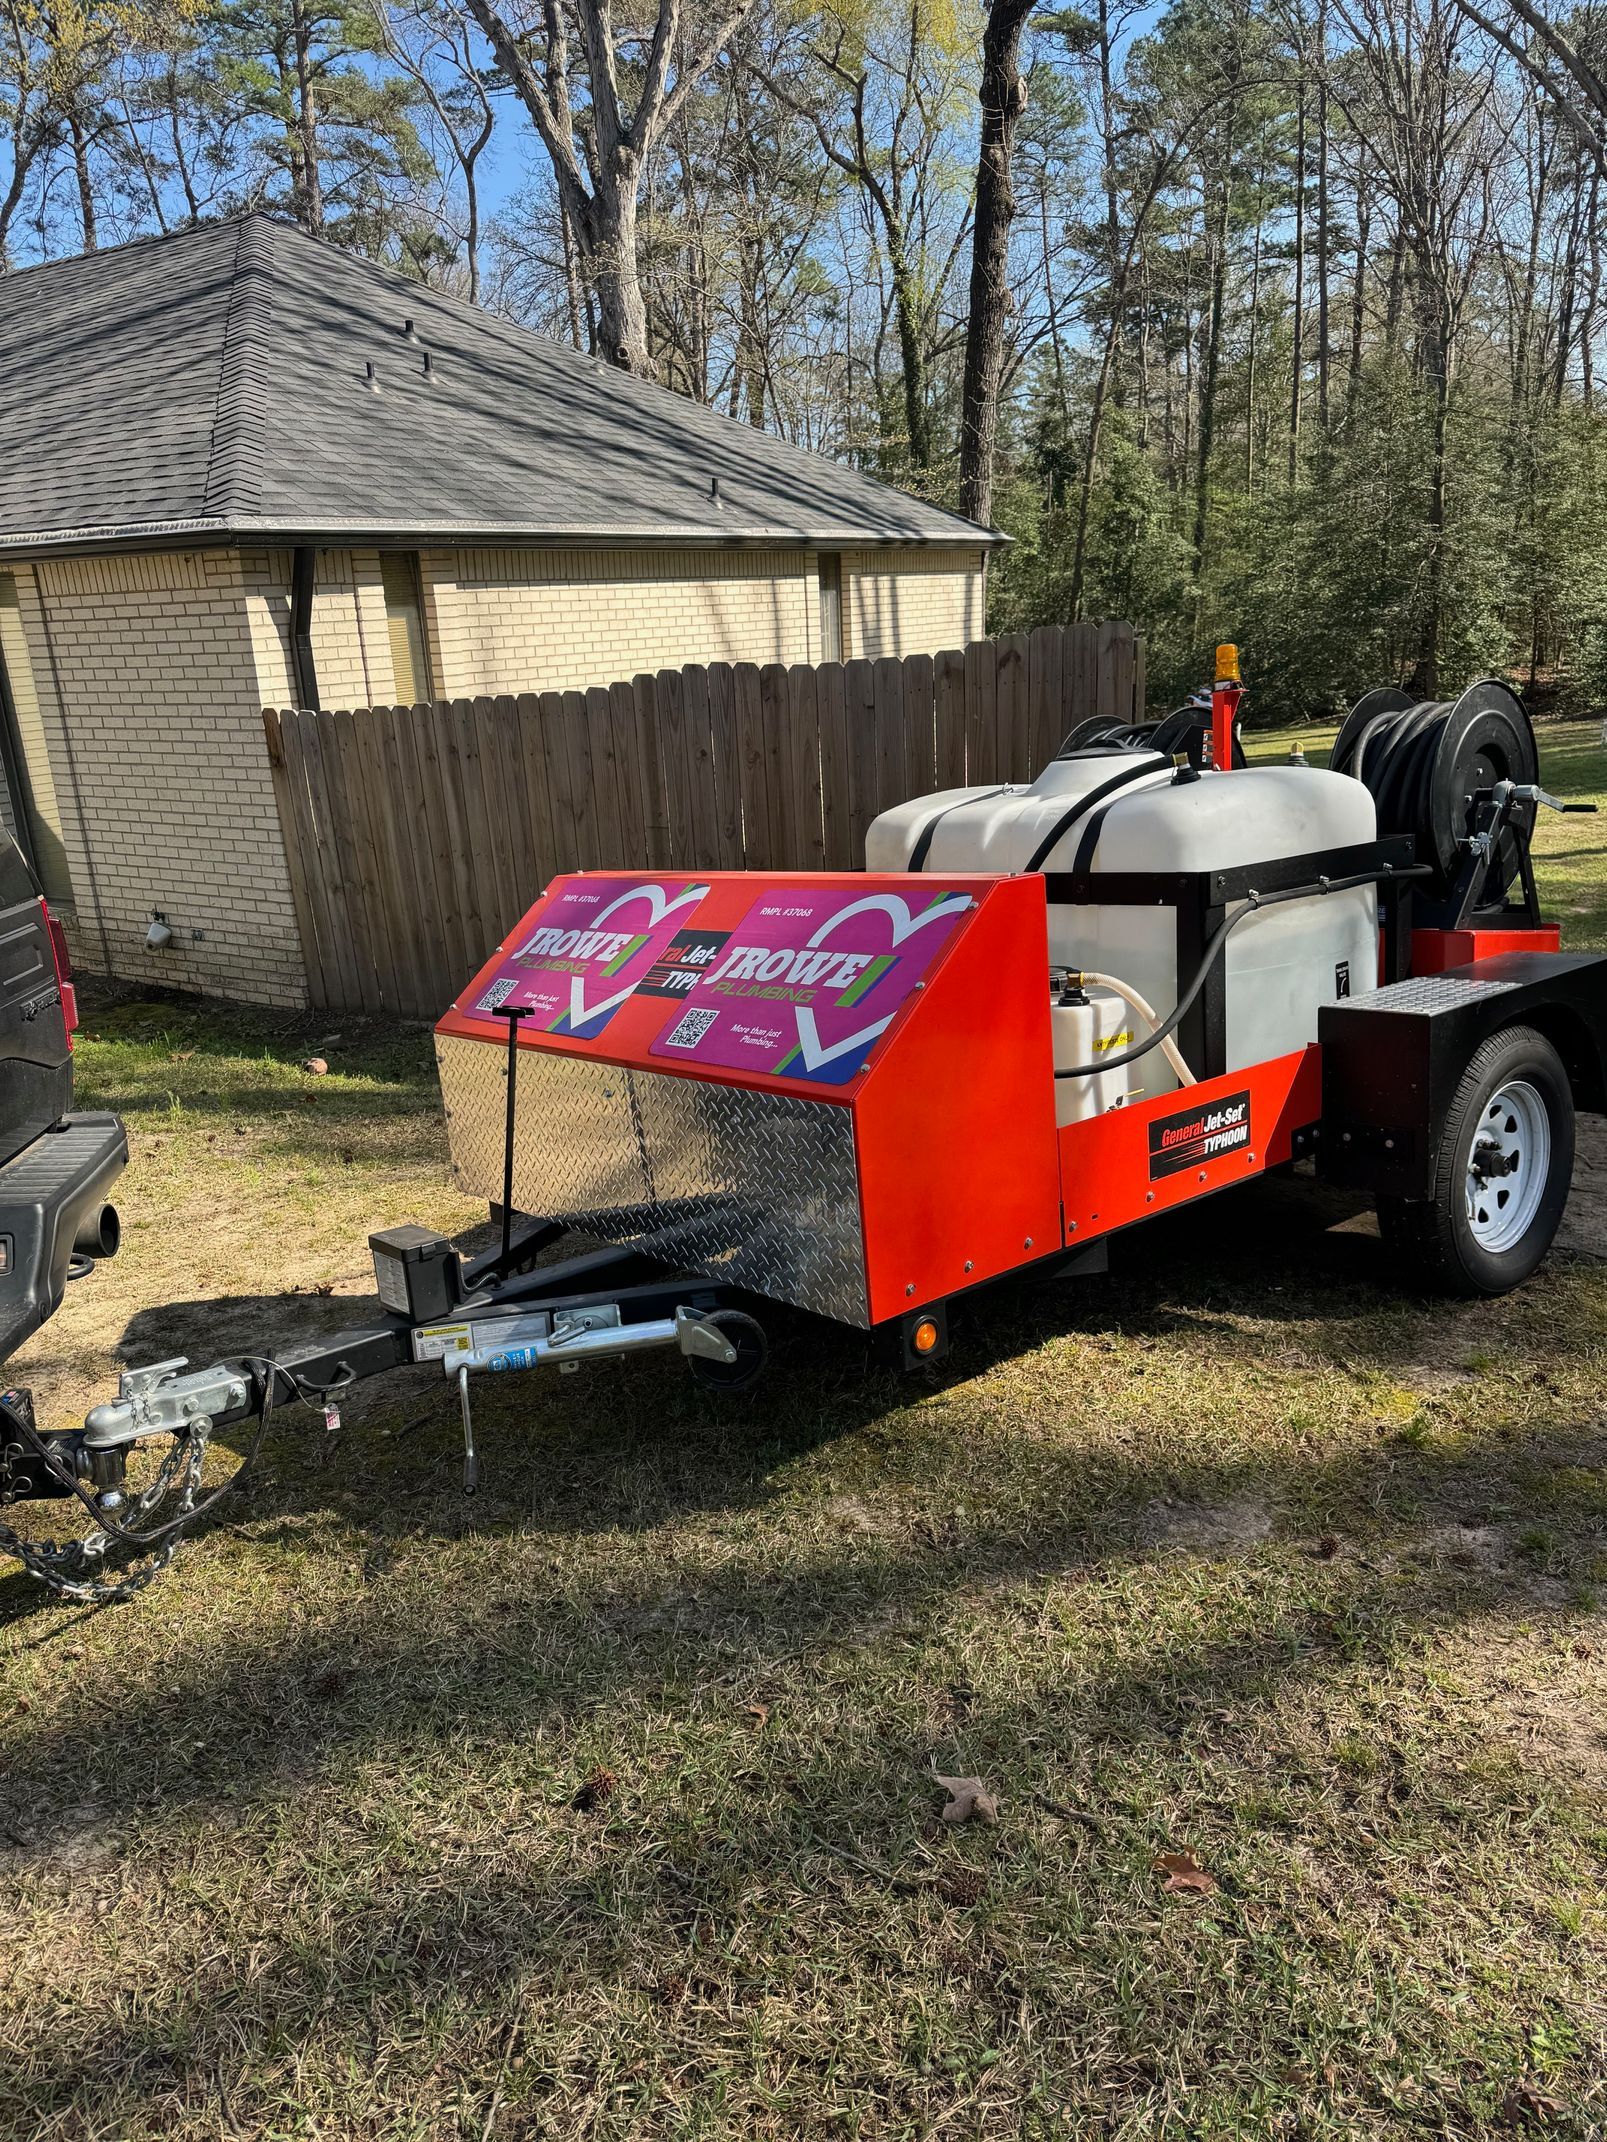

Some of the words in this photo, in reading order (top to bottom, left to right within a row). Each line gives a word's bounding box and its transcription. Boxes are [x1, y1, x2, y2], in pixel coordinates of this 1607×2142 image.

[561, 894, 578, 902] RMPL
[759, 907, 781, 916] RMPL
[782, 908, 814, 917] #37068
[510, 927, 635, 962] JROWE
[515, 956, 591, 974] PLUMBING
[680, 945, 717, 965] Jet-
[702, 946, 874, 989] JROWE
[661, 970, 702, 990] TYPH
[523, 991, 537, 999] More
[537, 992, 549, 1001] than
[710, 981, 818, 1003] PLUMBING
[730, 1024, 750, 1034] More
[750, 1026, 766, 1036] than
[764, 1028, 782, 1039] just
[1161, 1117, 1205, 1147] General
[1204, 1125, 1248, 1154] TYPHOON
